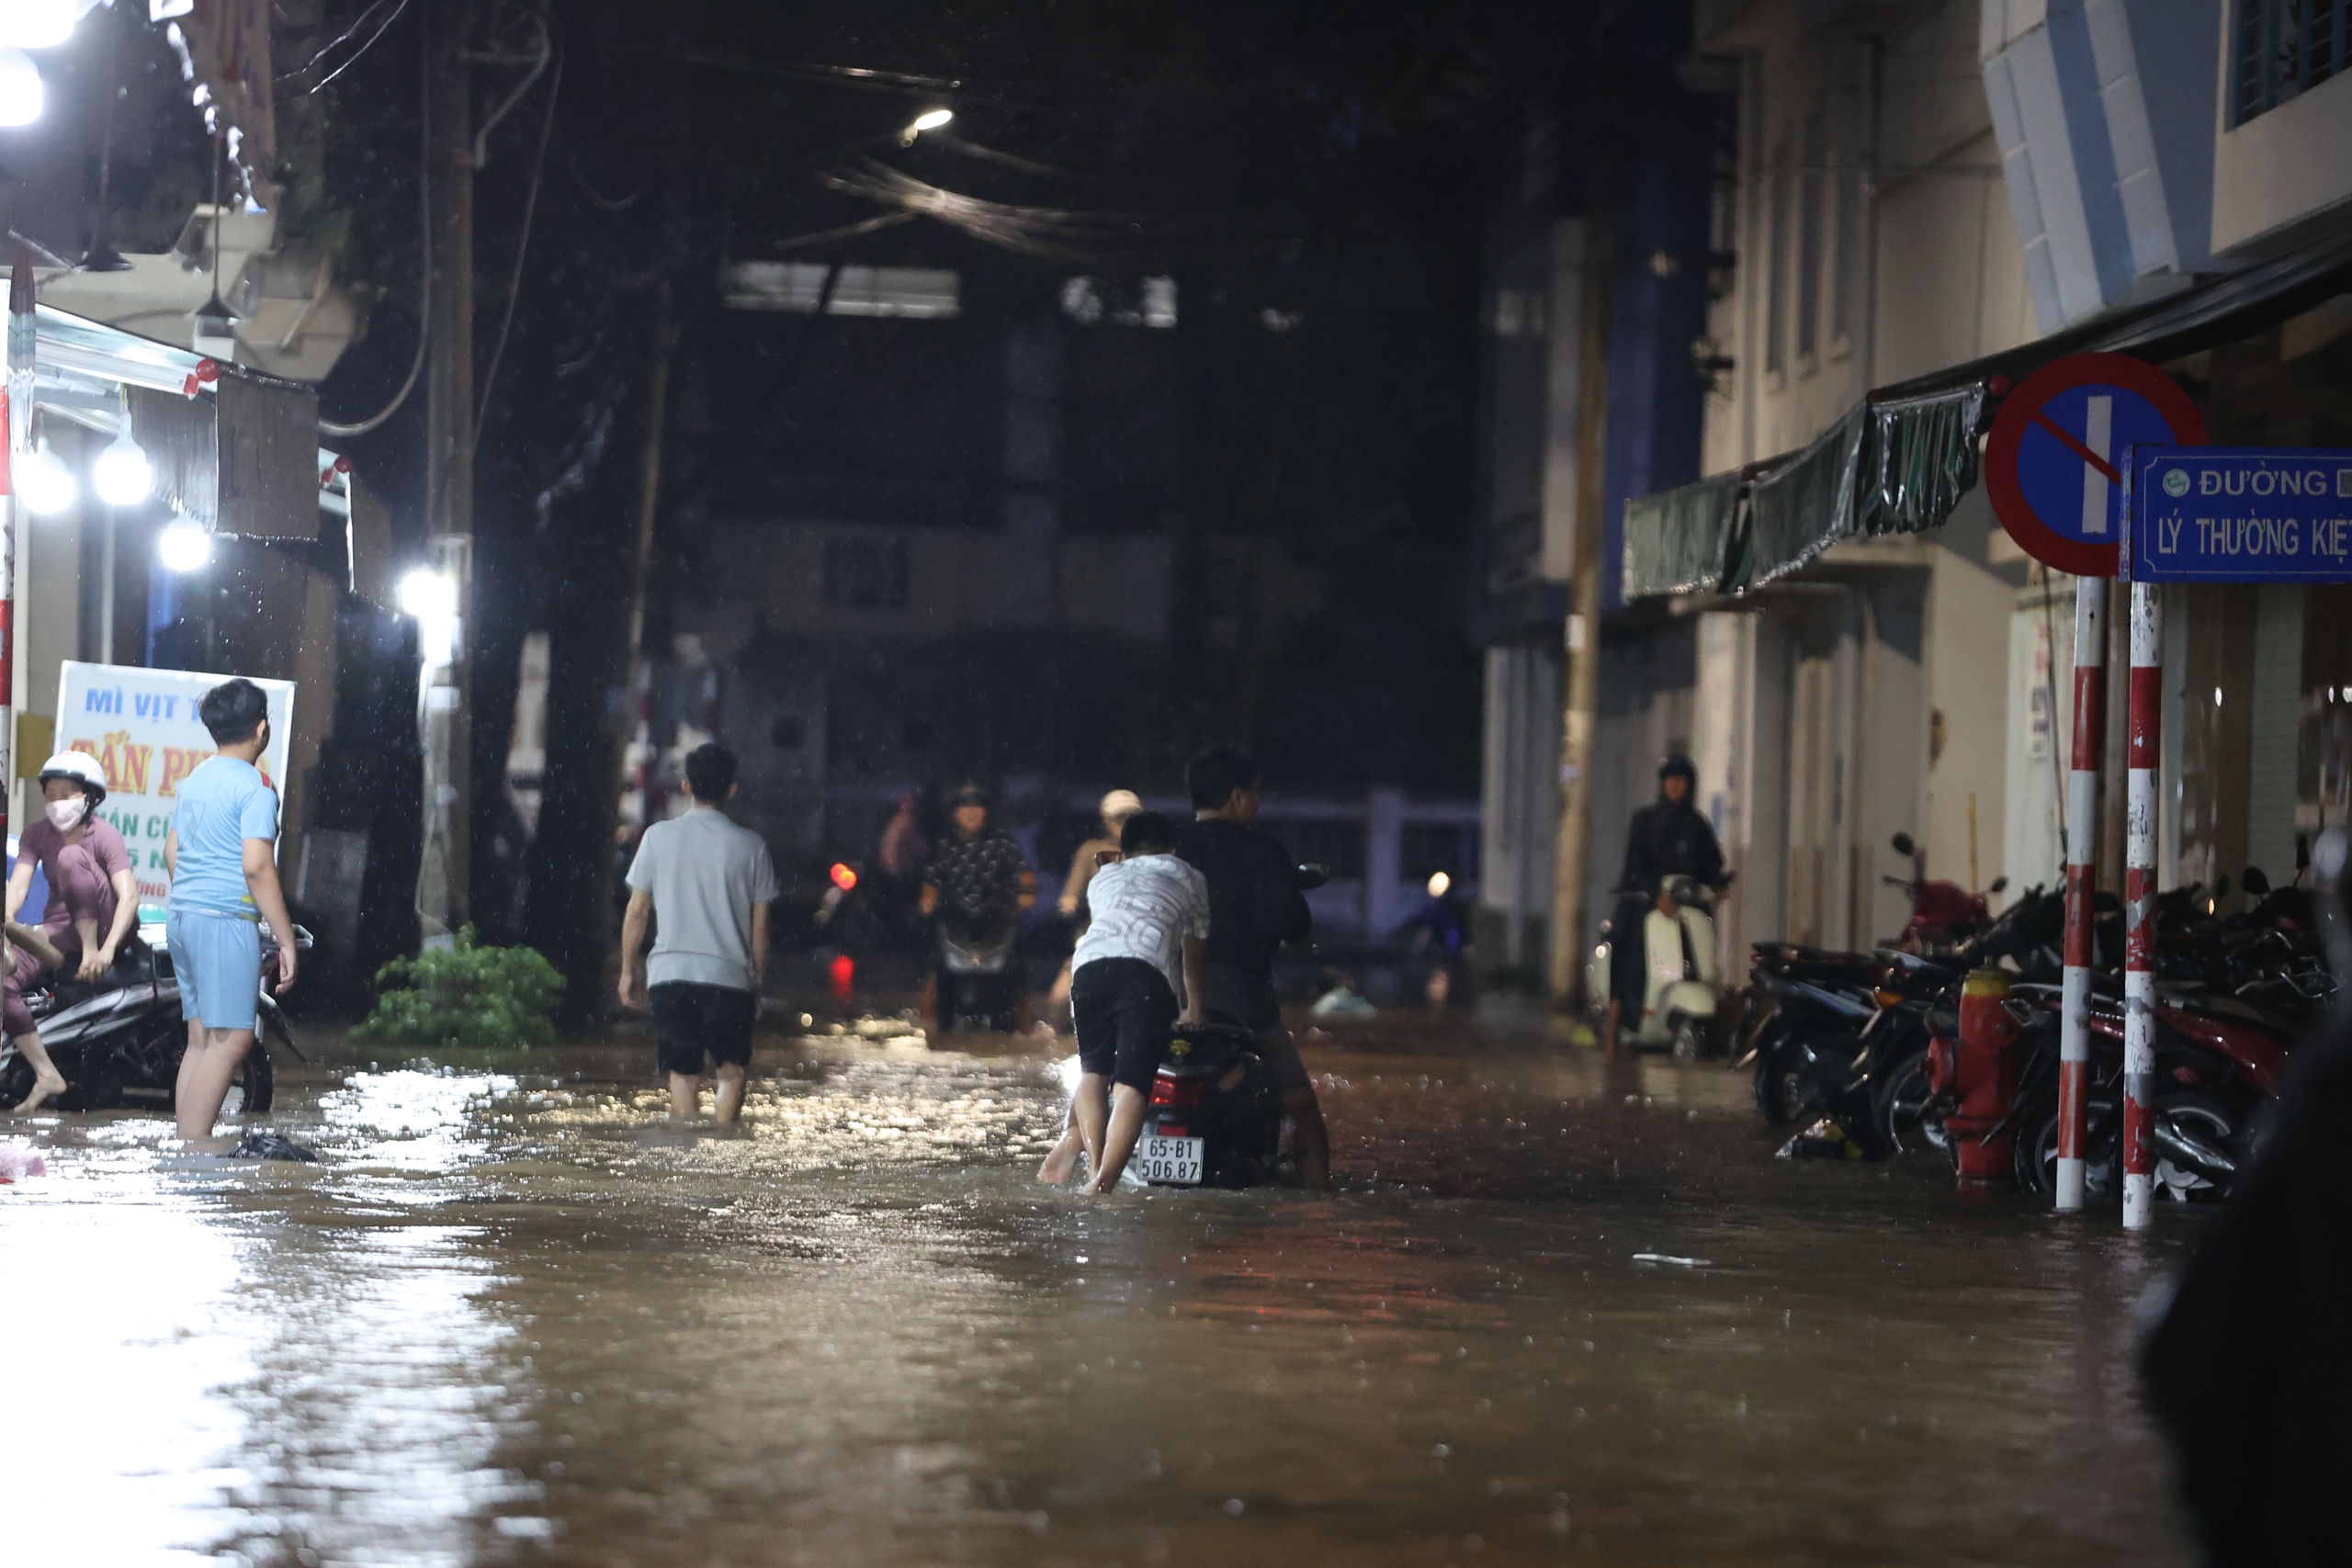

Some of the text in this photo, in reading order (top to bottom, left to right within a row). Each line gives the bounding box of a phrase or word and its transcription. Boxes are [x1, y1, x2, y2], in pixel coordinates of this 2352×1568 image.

[2199, 461, 2327, 496] ĐƯỜNG
[2158, 508, 2352, 564] LÝ THƯỜNG KIỆ
[85, 684, 123, 715] MÌ
[134, 691, 179, 723] VỊT
[1142, 1159, 1198, 1179] 506.87
